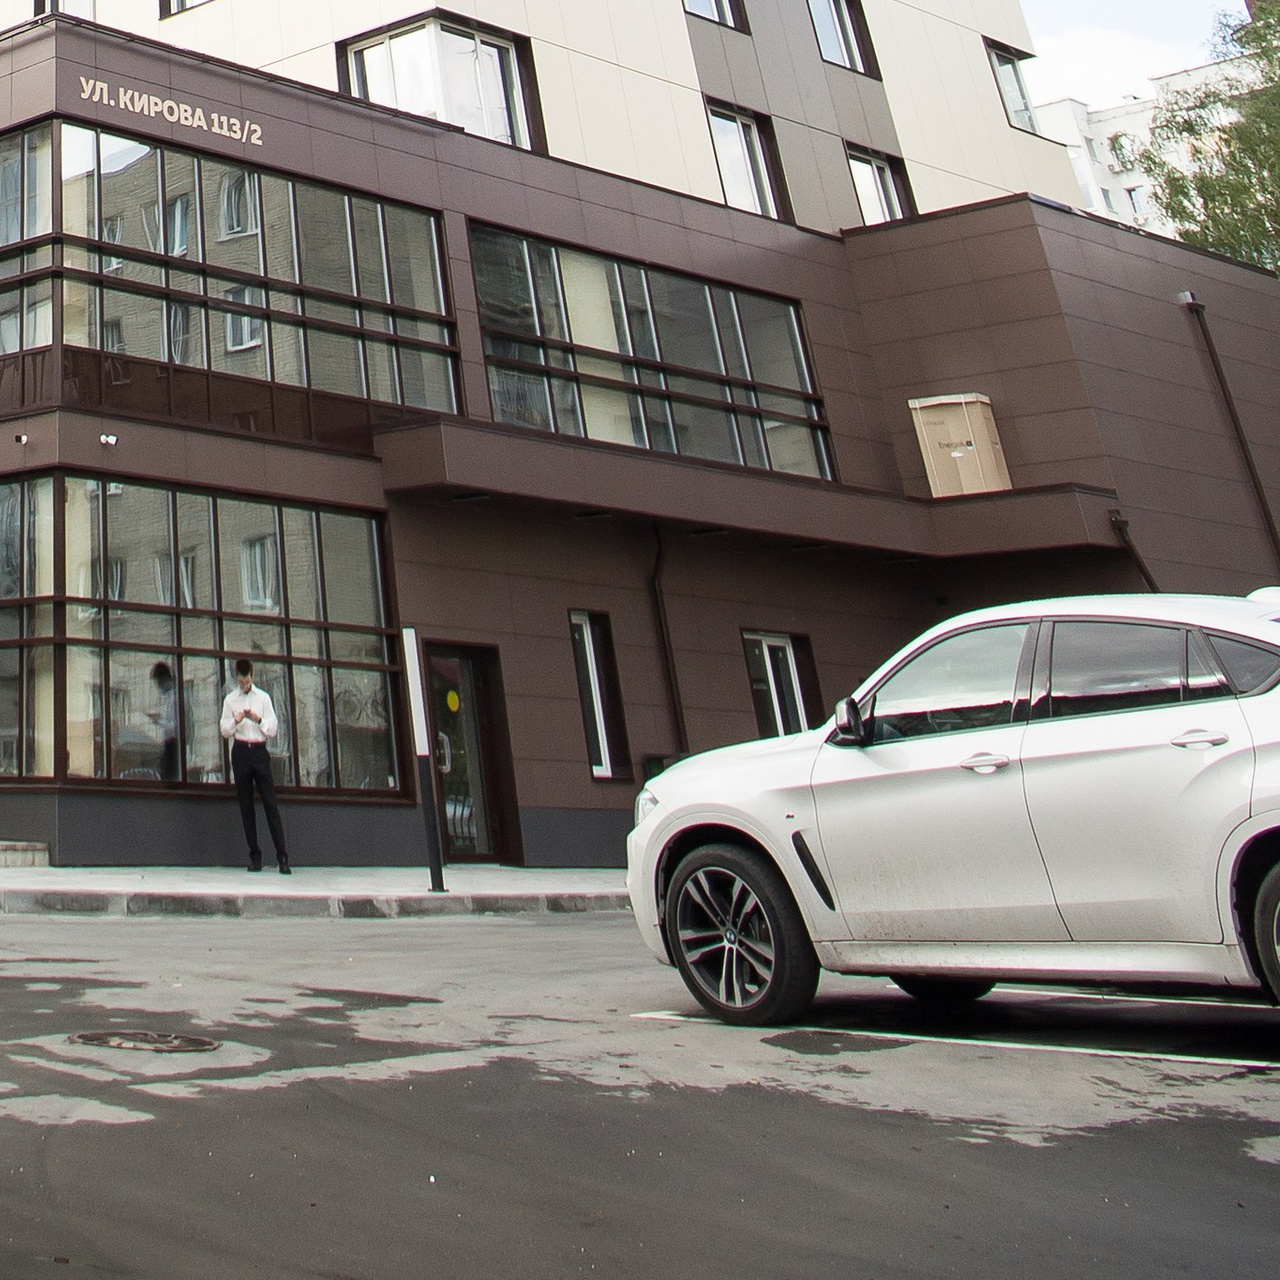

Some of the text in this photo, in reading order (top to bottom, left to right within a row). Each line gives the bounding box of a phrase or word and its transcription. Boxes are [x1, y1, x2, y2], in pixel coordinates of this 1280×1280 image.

[79, 76, 263, 146] УЛ. КИРОВА 113/2
